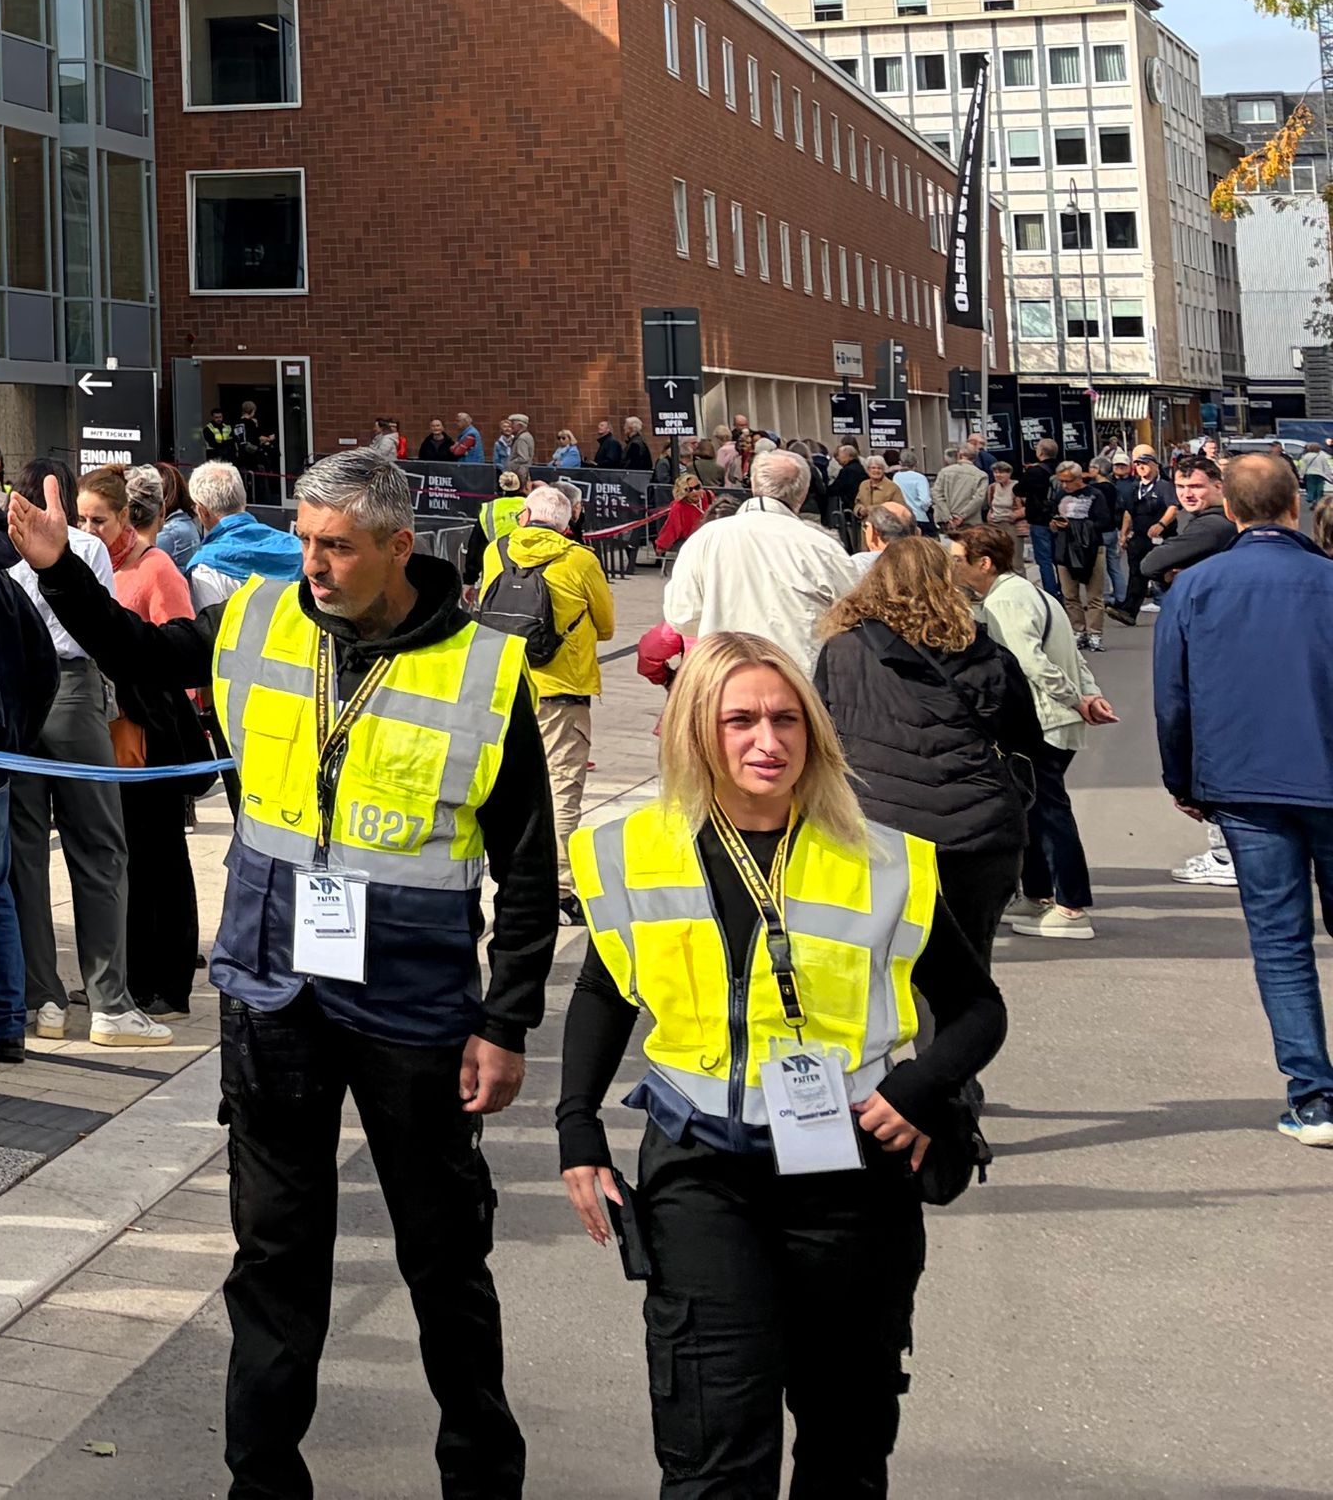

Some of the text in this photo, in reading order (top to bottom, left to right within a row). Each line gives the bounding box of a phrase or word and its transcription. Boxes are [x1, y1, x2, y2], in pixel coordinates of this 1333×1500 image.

[658, 412, 689, 420] EINGANG
[655, 427, 694, 435] BACKSTAGE
[80, 449, 132, 464] EINGANG
[429, 476, 453, 487] DEINE
[596, 483, 622, 494] DEINE
[429, 499, 451, 510] KÖLN.
[349, 801, 425, 849] 1827
